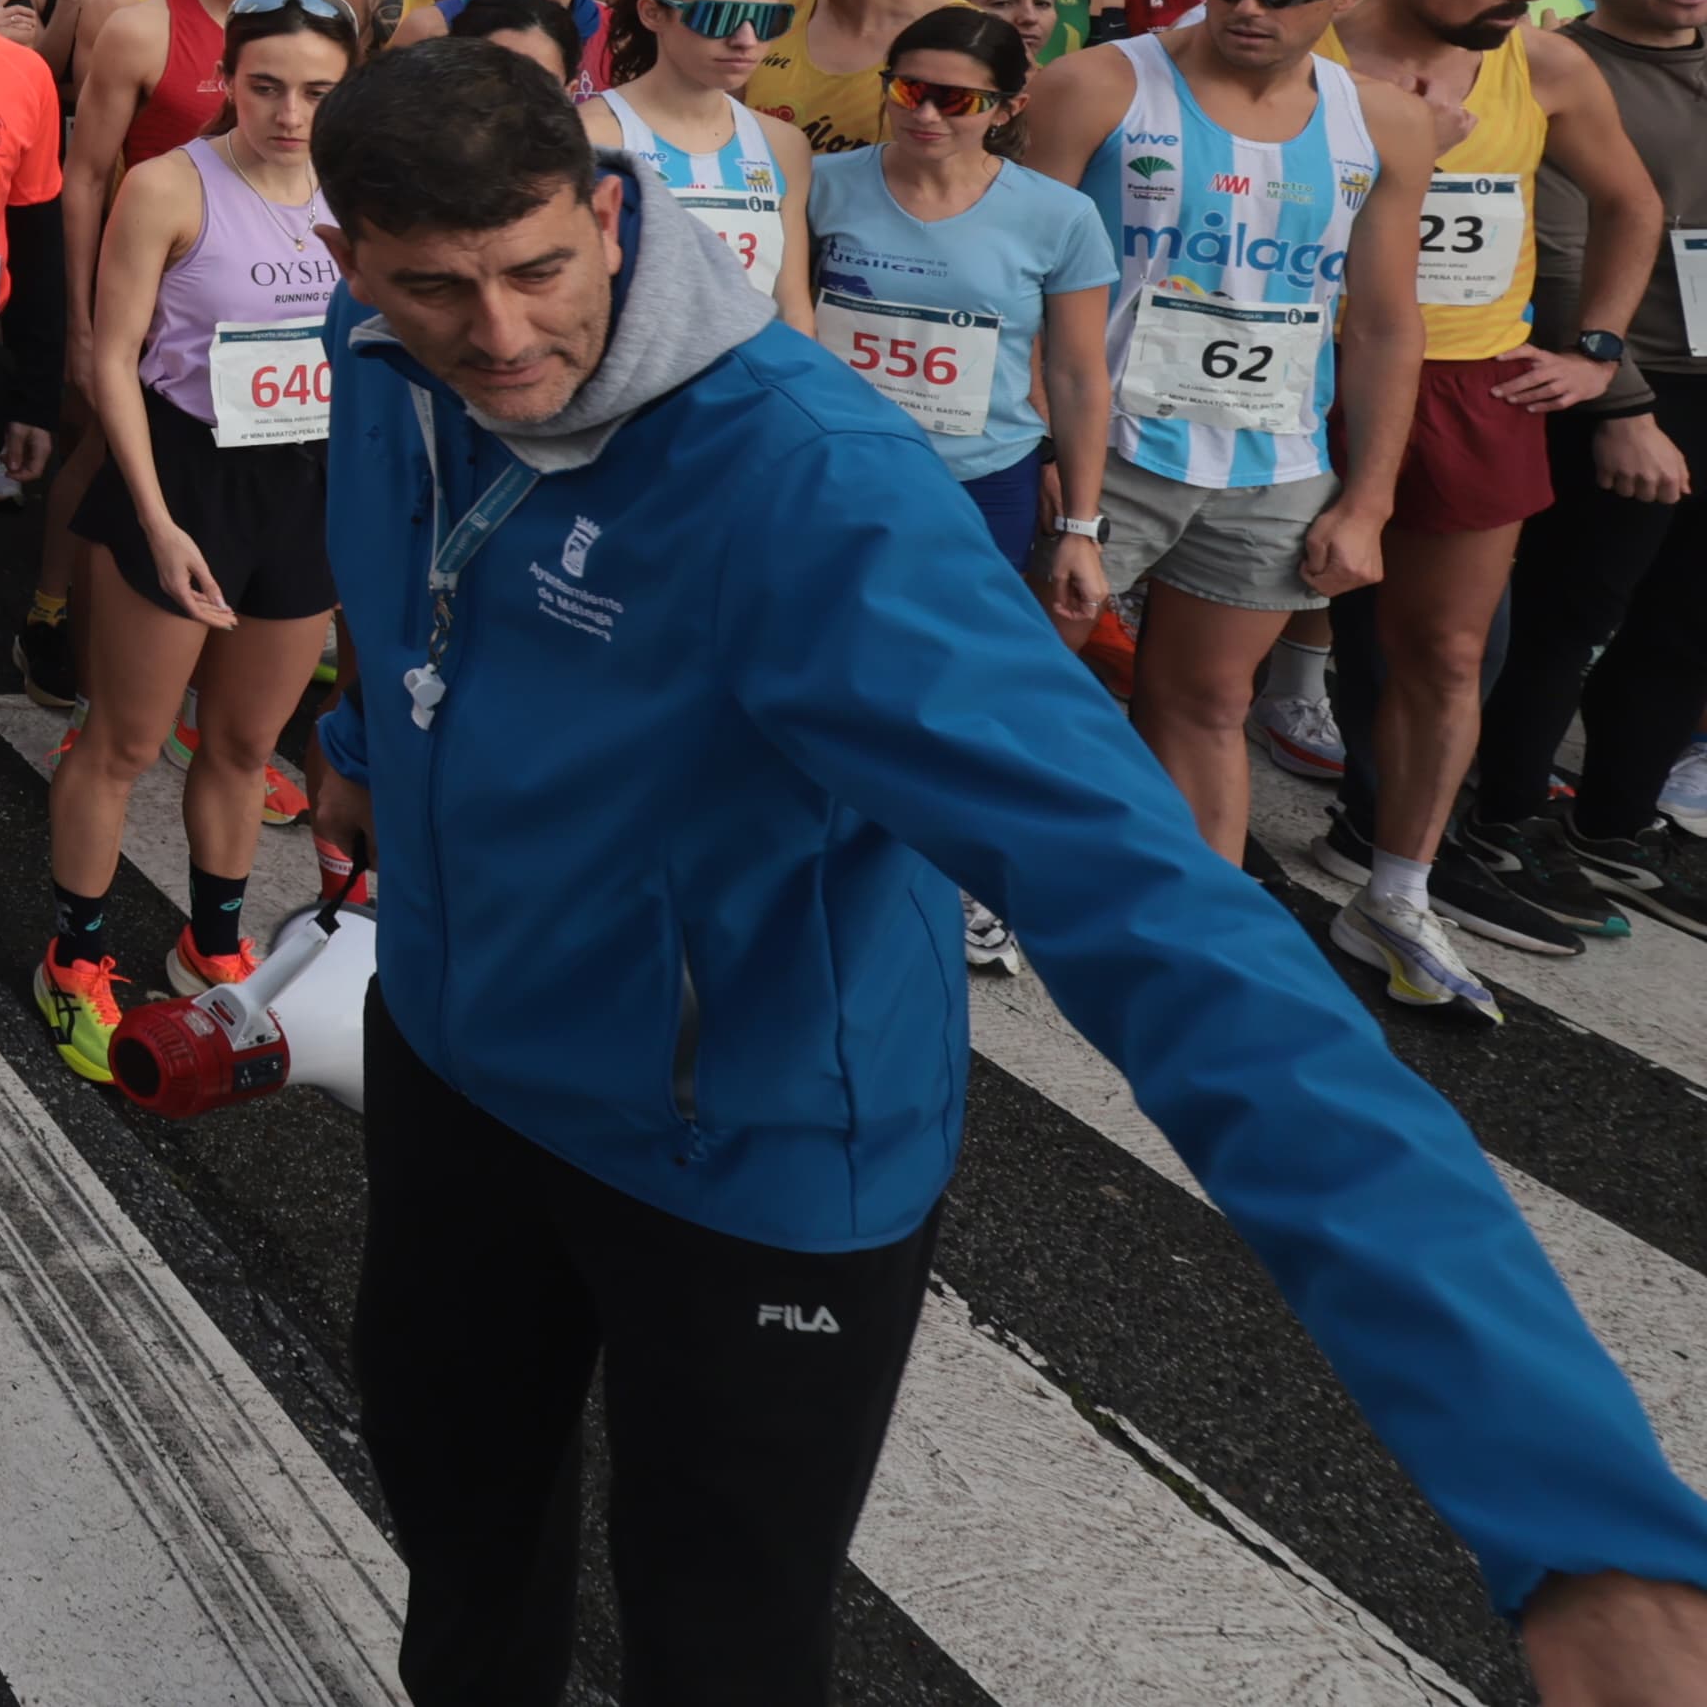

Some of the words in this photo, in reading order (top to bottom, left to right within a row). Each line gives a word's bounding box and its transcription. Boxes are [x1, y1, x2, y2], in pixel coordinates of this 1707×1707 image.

[1125, 132, 1179, 145] vive
[1127, 183, 1175, 192] Fundación
[275, 293, 319, 304] RUNNING
[850, 331, 958, 386] 556
[1201, 340, 1274, 383] 62
[251, 361, 332, 409] 640
[899, 400, 921, 411] PEÑA
[538, 587, 554, 603] de
[557, 595, 614, 627] Málaga
[758, 1303, 841, 1334] FILA
